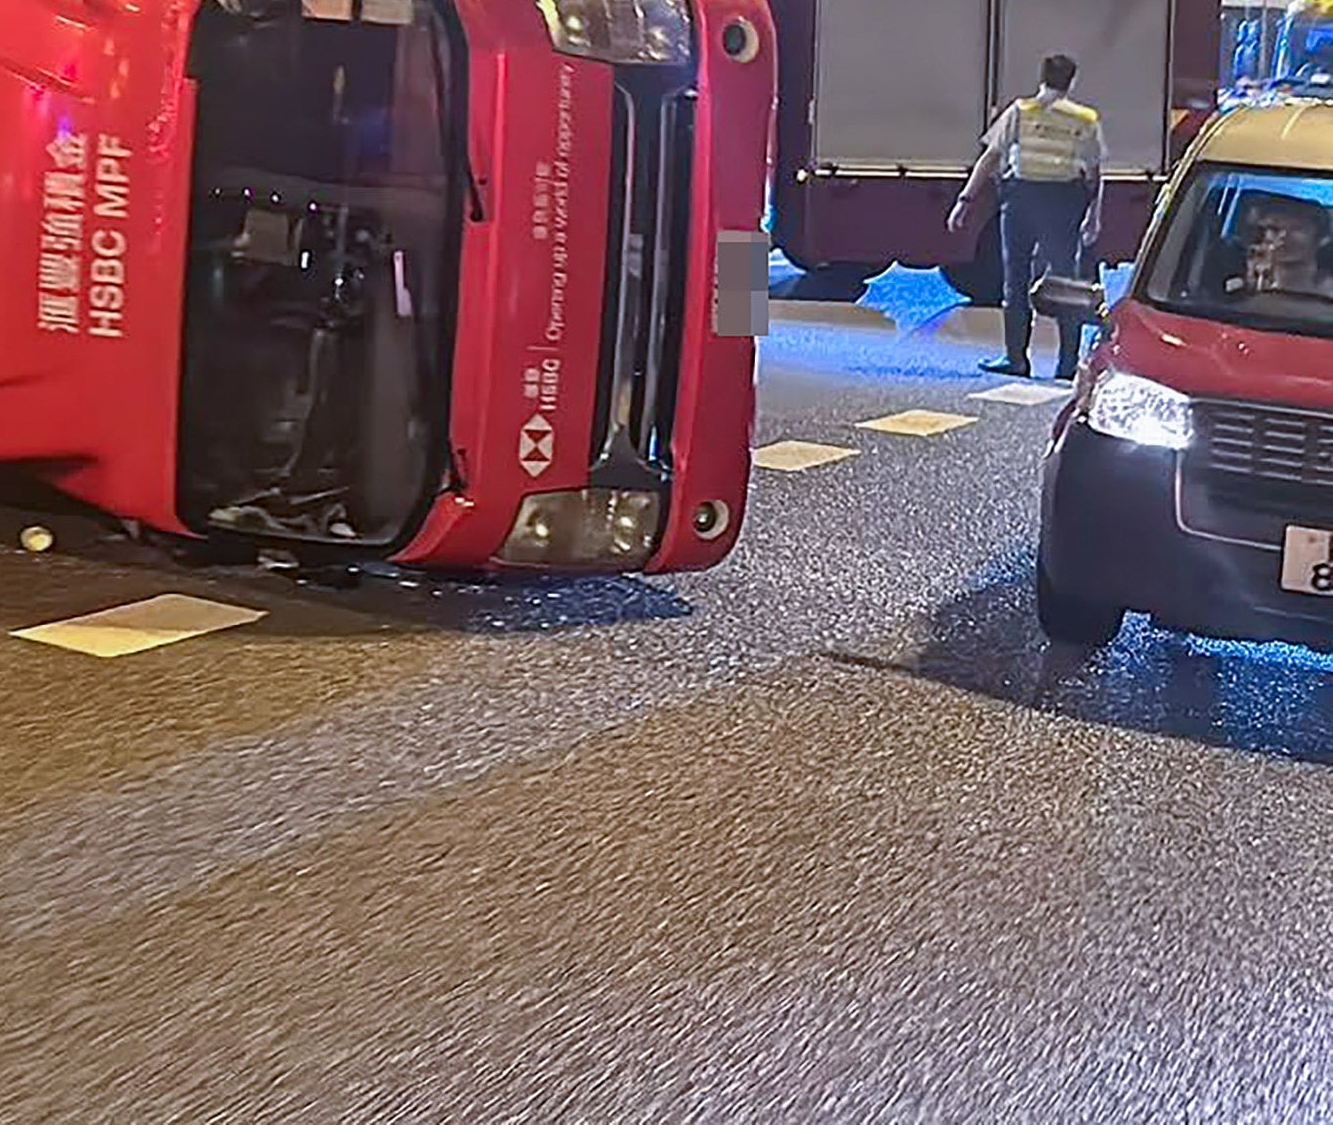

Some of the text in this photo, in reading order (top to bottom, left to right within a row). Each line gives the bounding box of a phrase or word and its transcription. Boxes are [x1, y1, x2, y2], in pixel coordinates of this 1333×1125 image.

[557, 63, 574, 157] opportunity
[553, 160, 570, 178] of
[553, 181, 568, 229] world
[89, 133, 133, 337] HSBC MPF
[553, 246, 569, 268] up
[545, 272, 568, 341] Opening
[539, 359, 560, 410] HSBC
